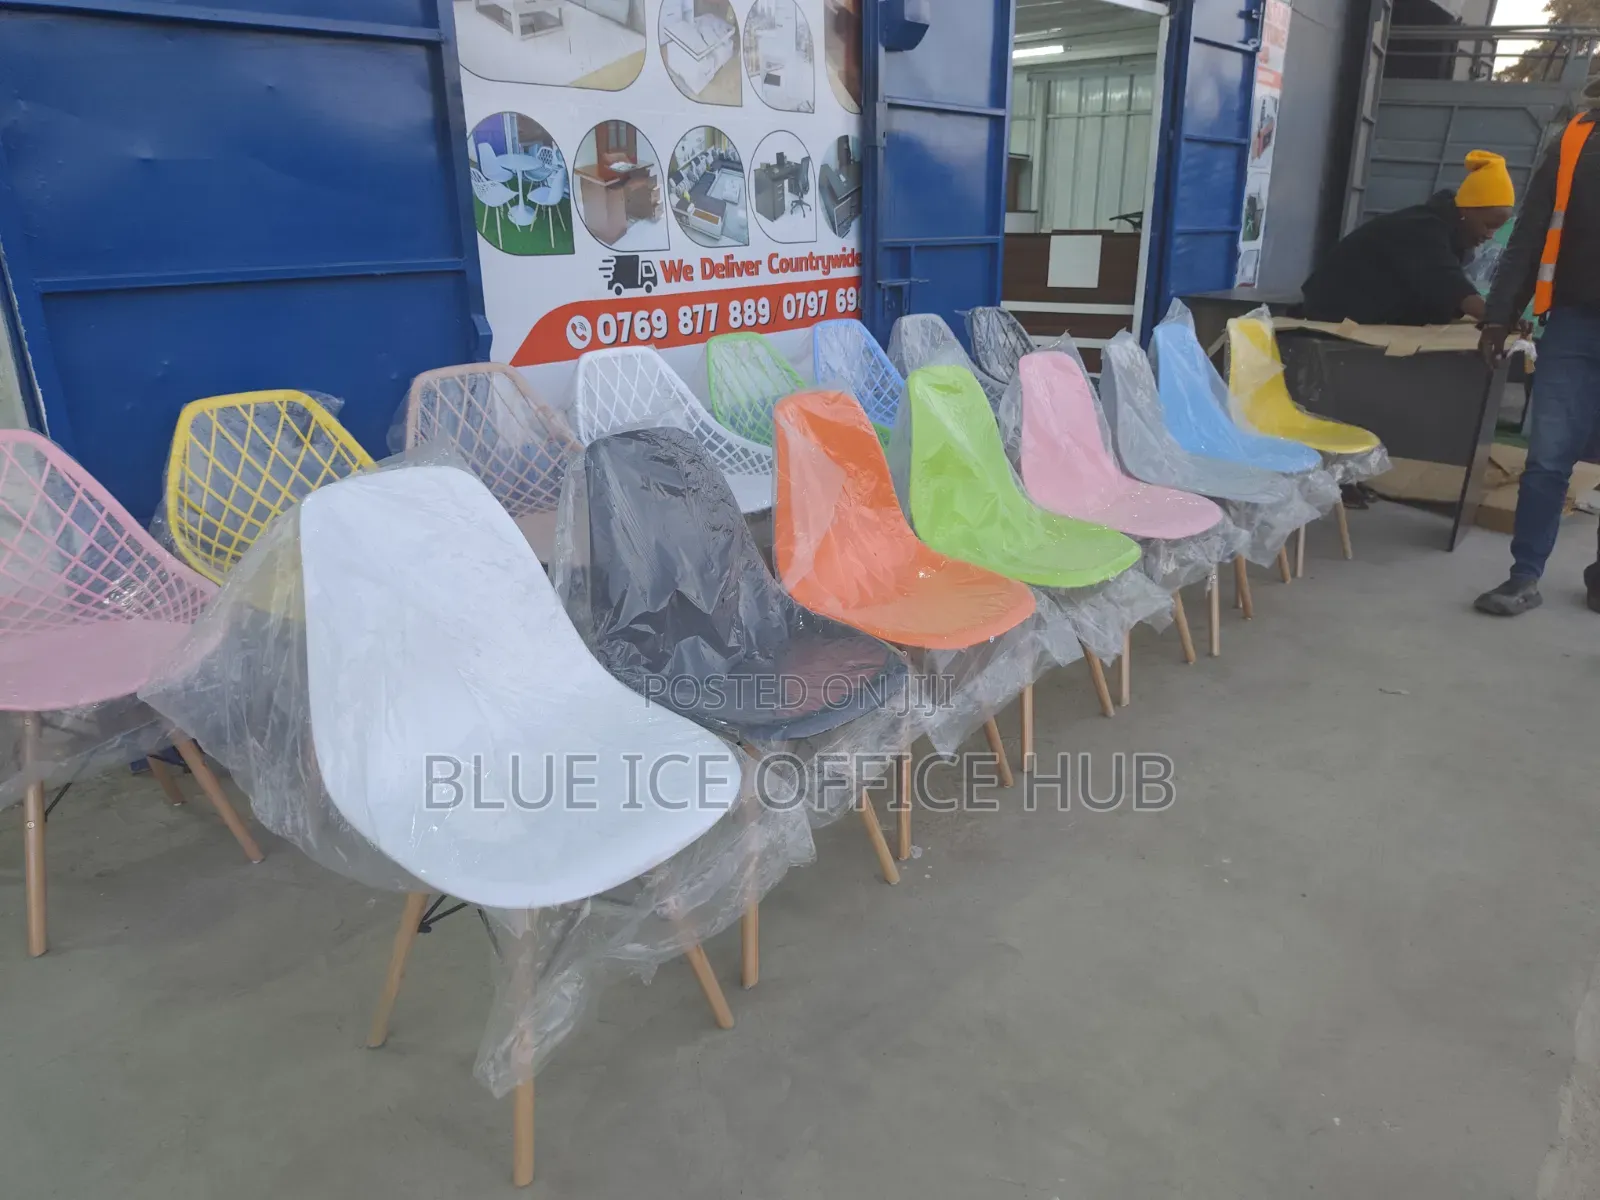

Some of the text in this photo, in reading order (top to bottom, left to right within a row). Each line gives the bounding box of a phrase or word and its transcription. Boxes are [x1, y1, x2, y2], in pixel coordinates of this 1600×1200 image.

[659, 246, 862, 284] We Deliver Countrywide
[596, 308, 669, 345] 0769
[678, 302, 719, 336] 877
[835, 286, 863, 314] 69
